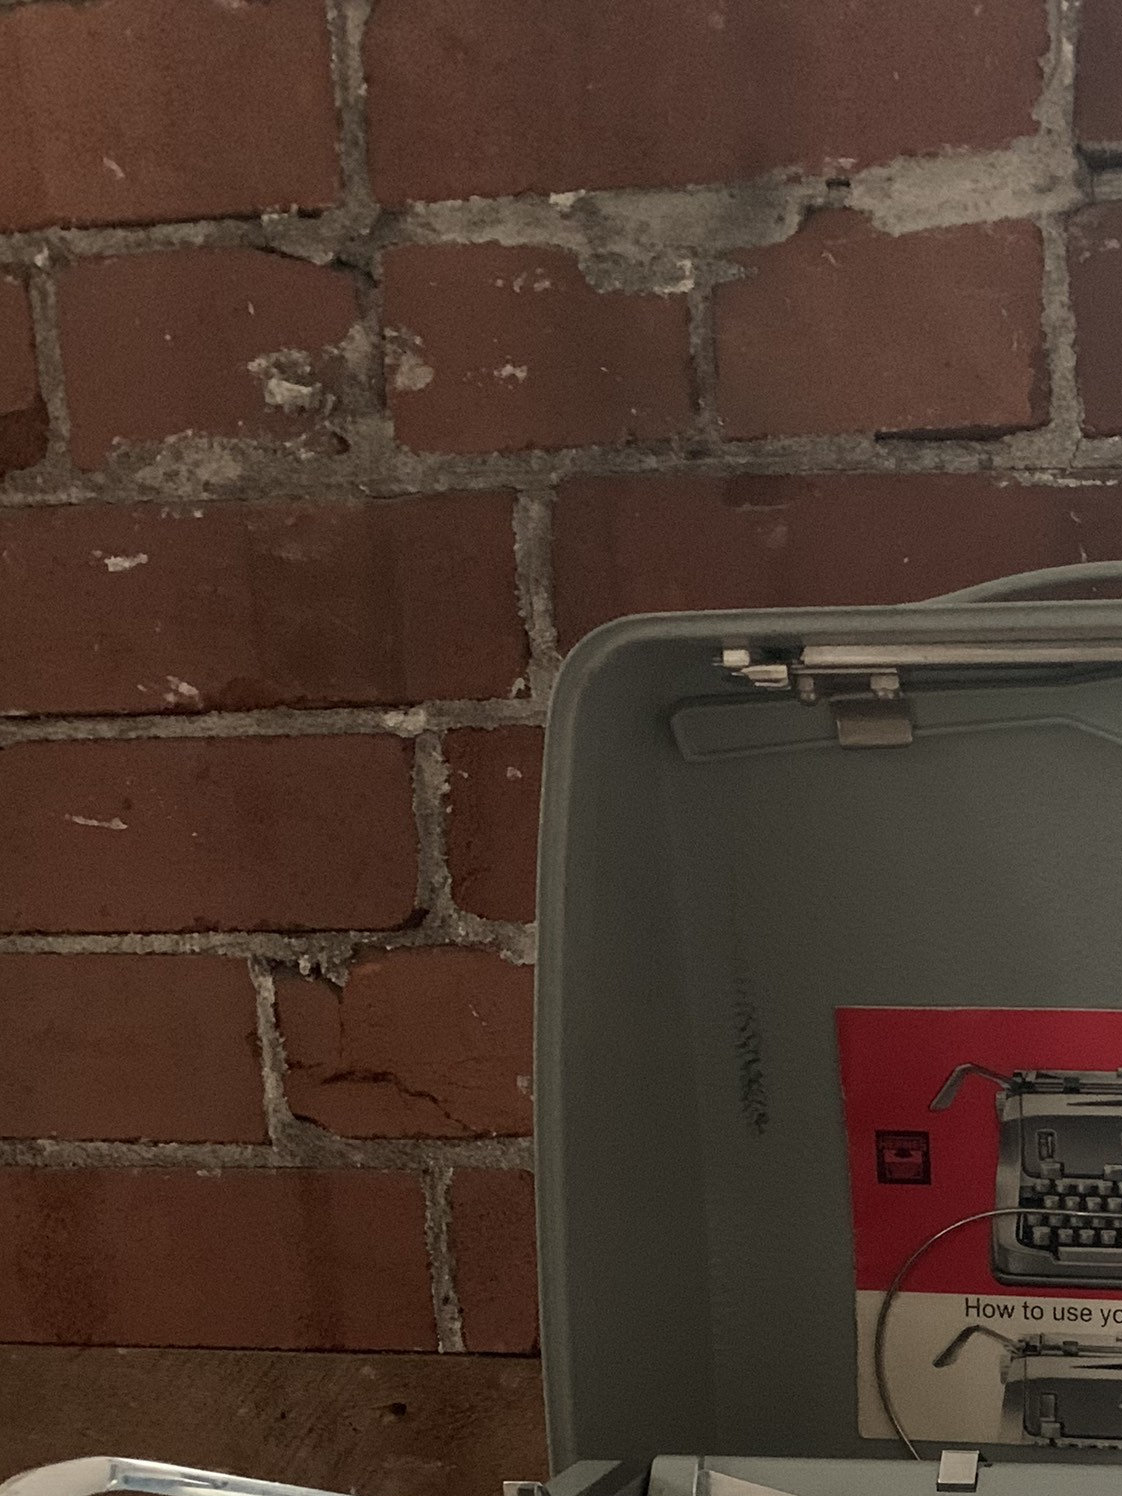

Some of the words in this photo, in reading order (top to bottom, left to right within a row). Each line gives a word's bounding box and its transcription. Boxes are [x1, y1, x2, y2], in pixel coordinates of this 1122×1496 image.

[965, 1298, 1015, 1320] How
[1022, 1300, 1043, 1320] to
[1053, 1306, 1092, 1322] use
